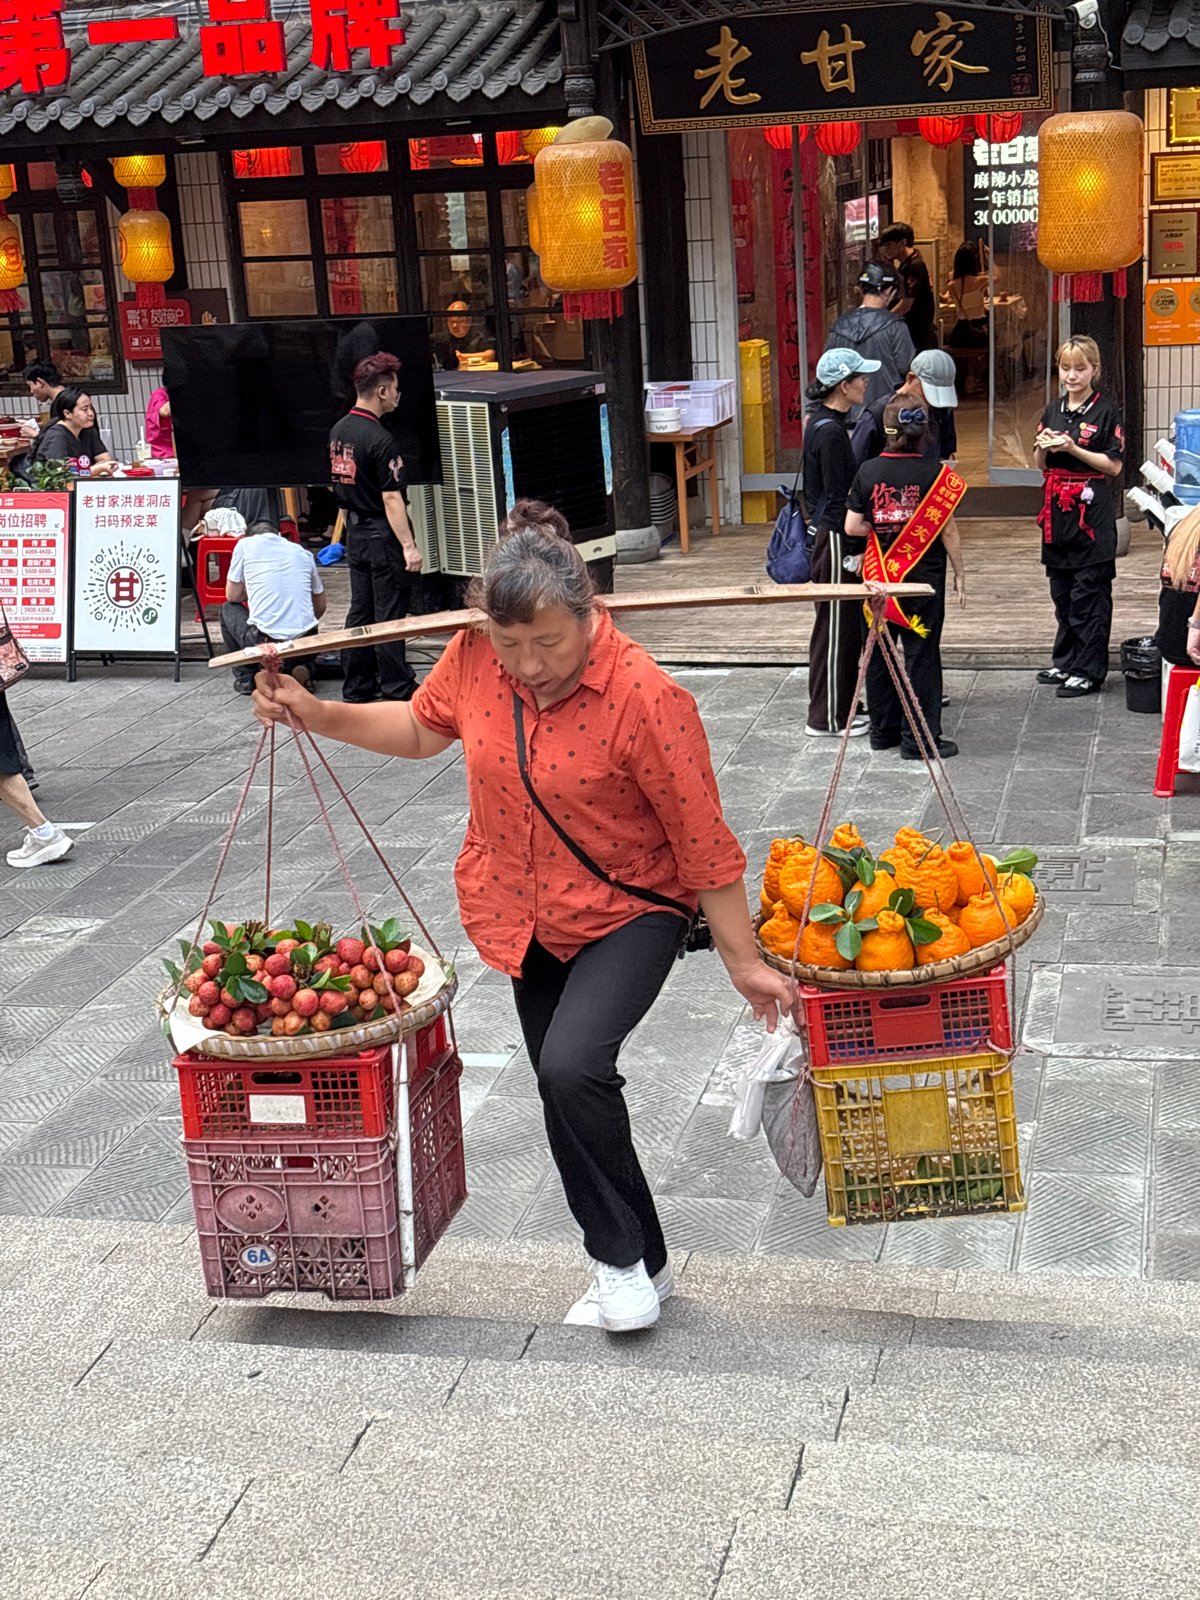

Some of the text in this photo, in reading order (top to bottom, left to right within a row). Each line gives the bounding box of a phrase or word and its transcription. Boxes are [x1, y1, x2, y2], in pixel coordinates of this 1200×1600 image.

[0, 0, 406, 93] 第一品牌
[693, 10, 990, 109] 老甘家
[973, 189, 1038, 209] 一年销量
[597, 161, 628, 270] 老甘家
[82, 494, 171, 508] 老甘家洪崖洞店
[94, 514, 158, 528] 扫码预定菜
[886, 505, 943, 577] 微笑天使
[110, 571, 140, 603] 甘
[246, 1248, 272, 1264] 6A
